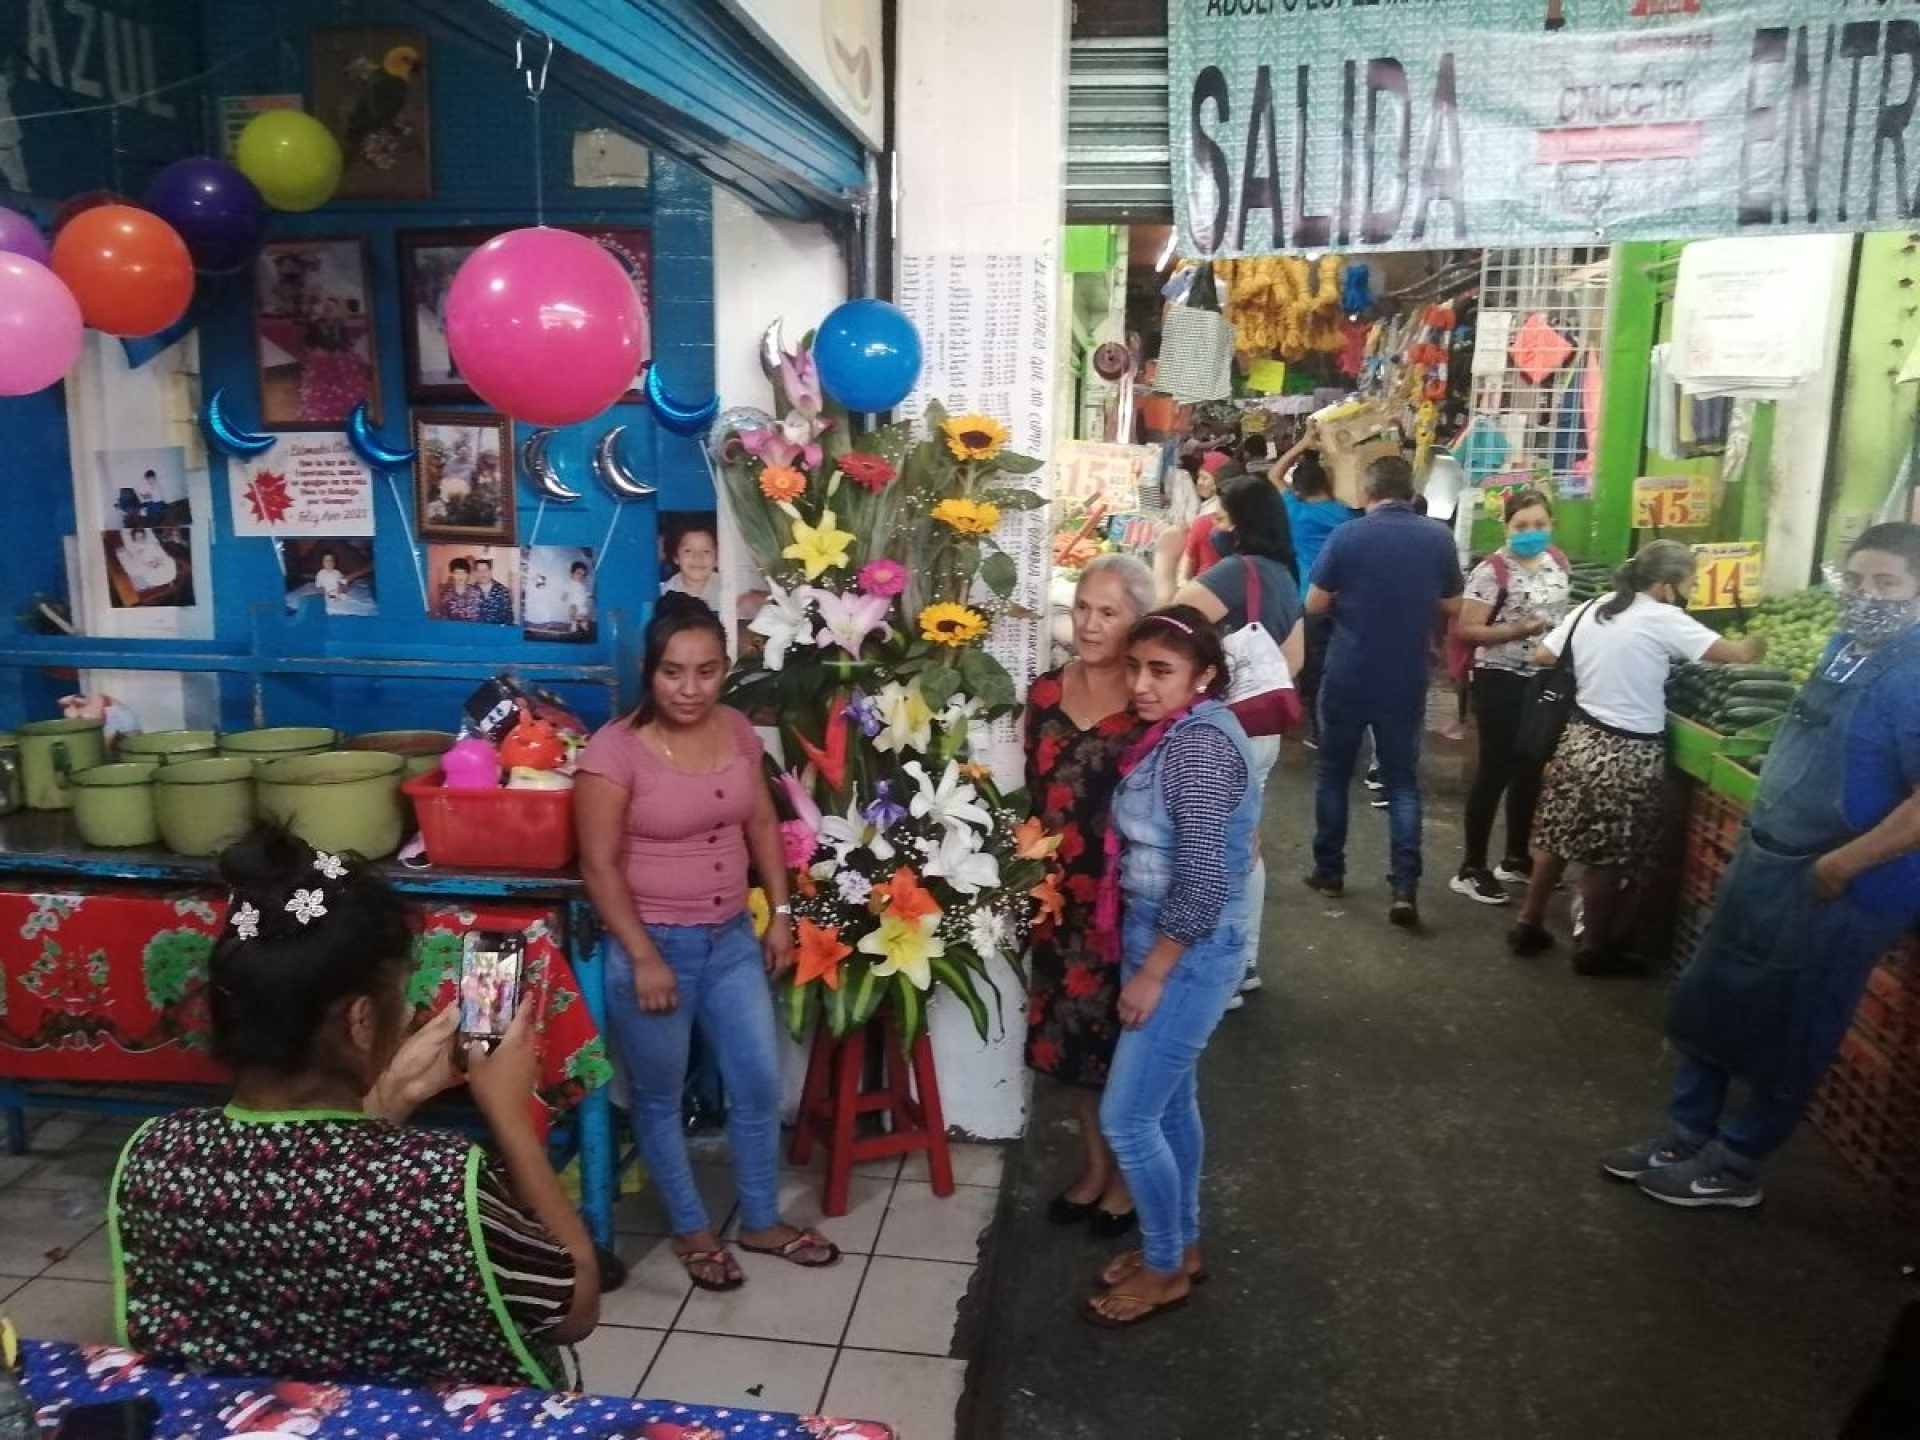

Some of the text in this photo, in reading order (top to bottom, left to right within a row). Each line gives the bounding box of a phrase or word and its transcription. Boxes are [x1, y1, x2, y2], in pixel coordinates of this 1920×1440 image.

[26, 0, 176, 118] AZUL
[1187, 52, 1467, 255] SALIDA
[1737, 19, 1920, 226] ENTR
